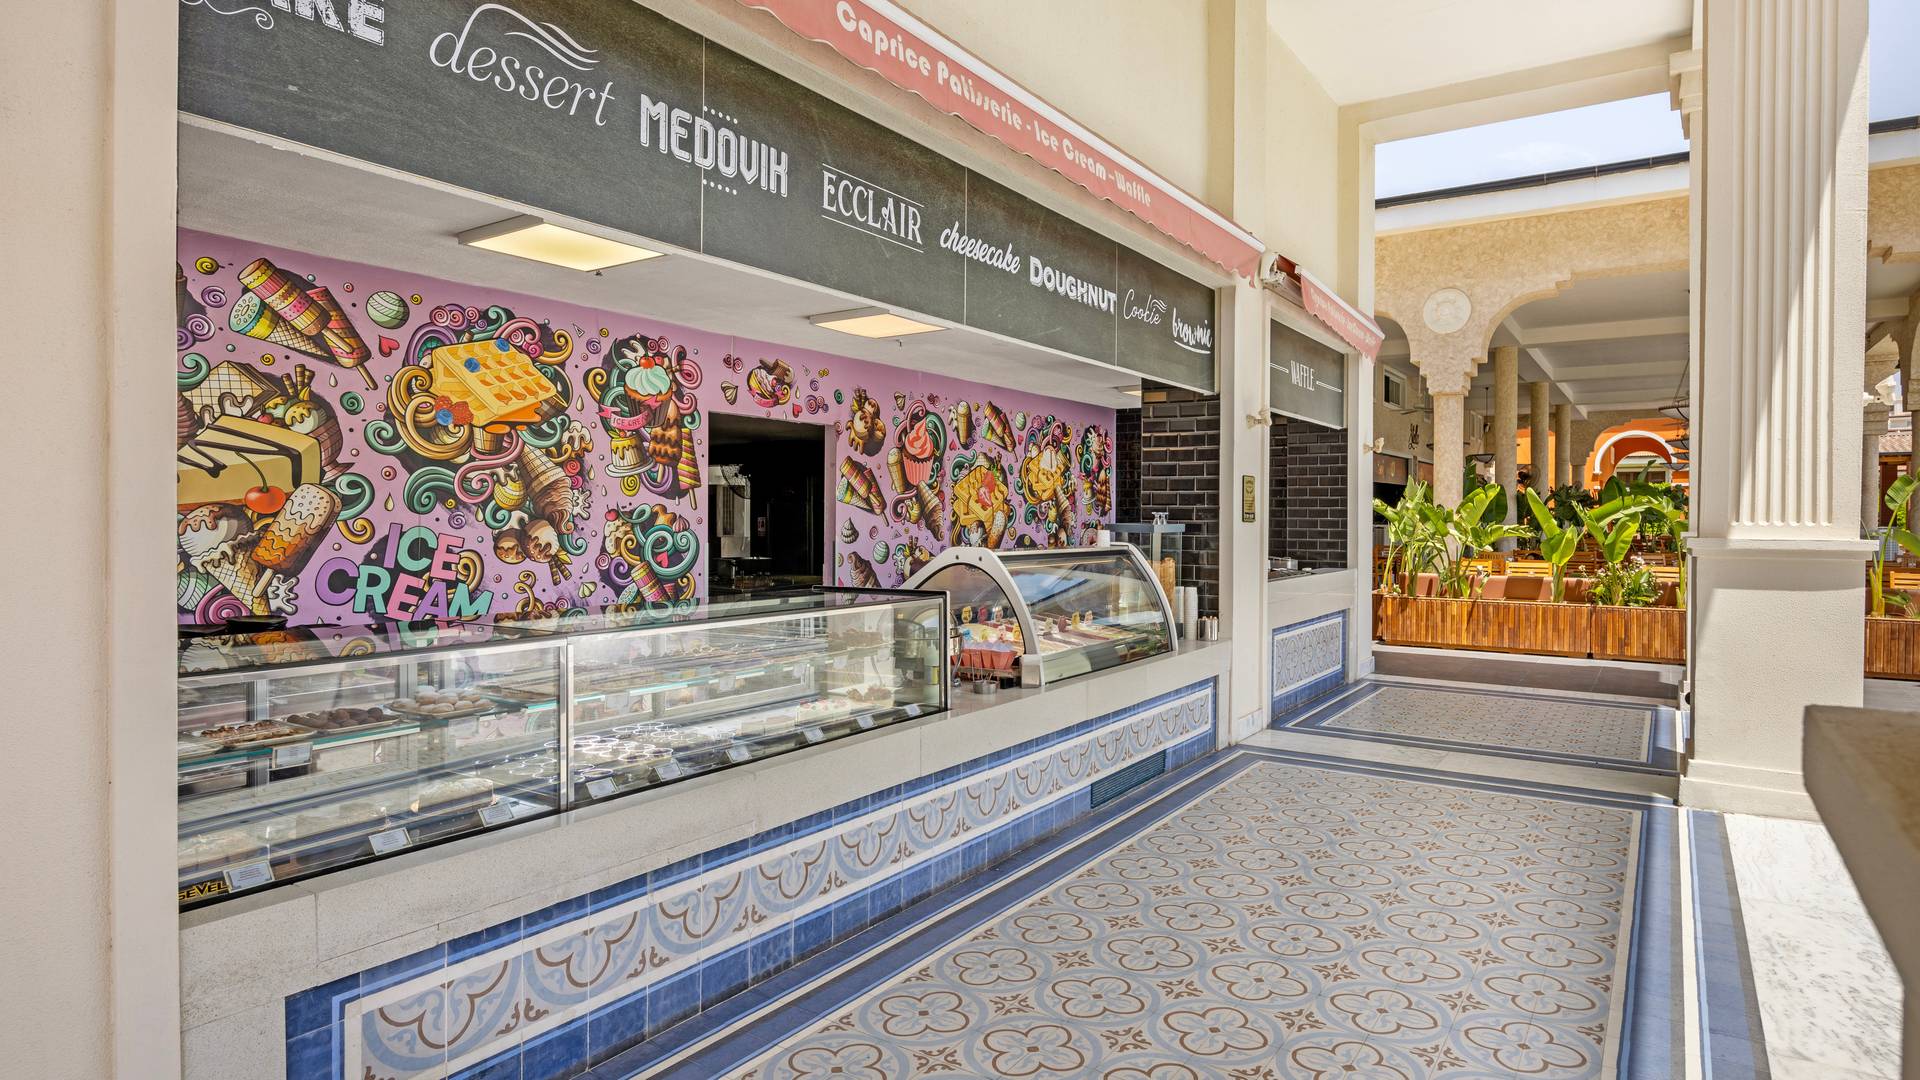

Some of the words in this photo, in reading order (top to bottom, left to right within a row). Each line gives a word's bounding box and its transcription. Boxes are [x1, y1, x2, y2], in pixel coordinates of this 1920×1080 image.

[429, 3, 616, 126] dessert
[836, 0, 931, 77] Caprice
[937, 60, 1022, 129] Patisserie
[1034, 120, 1059, 152] Ice
[640, 93, 788, 197] MEDOVIK
[822, 170, 922, 245] ECCLAIR
[939, 221, 1020, 274] cheesecake
[1123, 288, 1167, 325] Cookie
[1172, 307, 1213, 349] brownie
[1290, 360, 1315, 391] WAFFLE
[383, 522, 465, 581] ICE
[315, 556, 494, 622] CREAM
